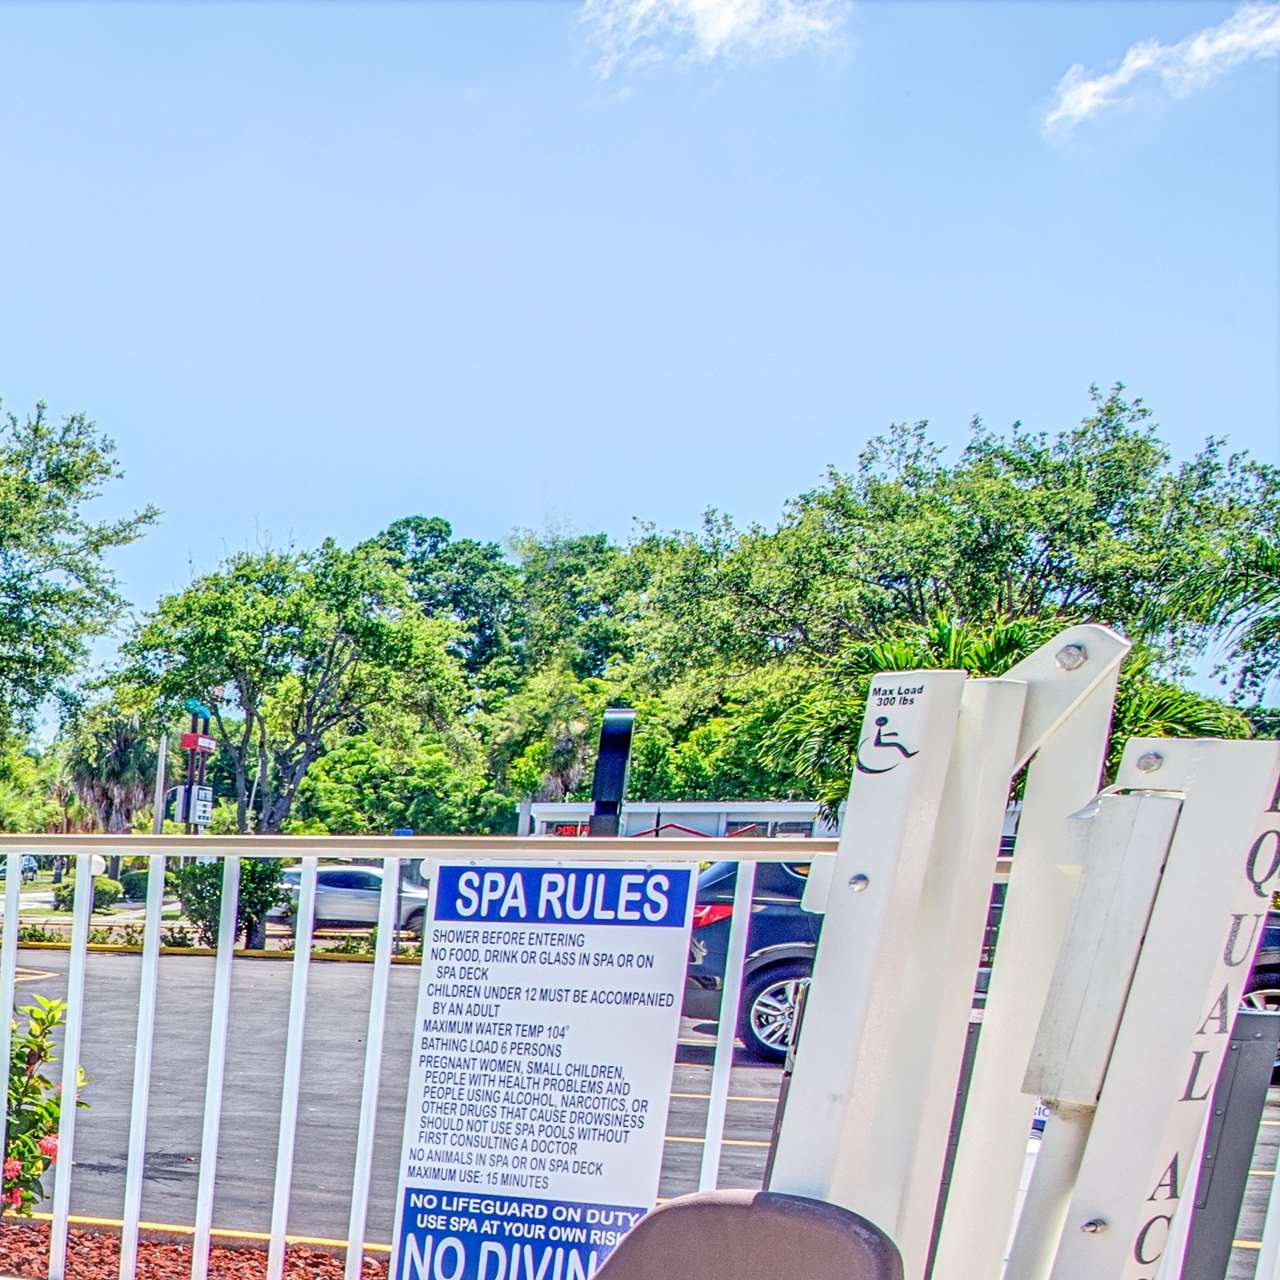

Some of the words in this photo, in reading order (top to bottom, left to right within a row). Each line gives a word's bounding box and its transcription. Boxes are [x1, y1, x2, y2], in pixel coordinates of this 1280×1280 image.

[872, 687, 894, 697] Max
[898, 685, 925, 696] Load
[876, 697, 895, 706] 300
[898, 697, 915, 706] lbs
[455, 871, 527, 918] SPA
[537, 872, 670, 922] RULES
[433, 929, 479, 943] SHOWER
[481, 931, 526, 945] BEFORE
[528, 932, 585, 947] ENTERING
[431, 948, 446, 961] NO
[449, 948, 481, 964] FOOD,
[484, 949, 518, 963] DRINK
[521, 951, 537, 964] OR
[539, 951, 576, 966] GLASS
[579, 953, 590, 966] IN
[593, 953, 614, 967] SPA
[617, 954, 634, 968] OR
[636, 955, 654, 968] ON
[436, 965, 456, 979] SPA
[459, 967, 489, 981] DECK
[427, 983, 482, 998] CHILDREN
[484, 986, 521, 1000] UNDER
[525, 988, 537, 1001] 12
[539, 988, 570, 1002] MUST
[573, 989, 589, 1003] BE
[590, 990, 674, 1007] ACCOMPANIED
[432, 1002, 447, 1015] BY
[448, 1002, 464, 1016] AN
[465, 1003, 501, 1018] ADULT
[423, 1019, 473, 1034] MAXIMUM
[475, 1021, 513, 1036] WATER
[515, 1024, 544, 1038] TEMP
[421, 1037, 467, 1052] BATHING
[470, 1040, 498, 1054] LOAD
[501, 1042, 508, 1055] 6
[509, 1042, 562, 1057] PERSONS
[419, 1055, 478, 1070] PREGNANT
[480, 1059, 523, 1074] WOMEN,
[527, 1061, 562, 1076] SMALL
[565, 1063, 625, 1080] CHILDREN,
[425, 1070, 466, 1086] PEOPLE
[468, 1073, 496, 1087] WITH
[498, 1075, 540, 1090] HEALTH
[543, 1077, 604, 1094] PROBLEMS
[606, 1081, 631, 1096] AND
[423, 1085, 465, 1101] PEOPLE
[467, 1088, 501, 1103] USING
[503, 1091, 557, 1108] ALCOHOL,
[560, 1095, 628, 1113] NARCOTICS,
[631, 1099, 649, 1113] OR
[421, 1101, 458, 1116] OTHER
[460, 1103, 497, 1119] DRUGS
[500, 1106, 528, 1120] THAT
[529, 1108, 567, 1124] CAUSE
[569, 1111, 645, 1129] DROWSINESS
[420, 1116, 464, 1131] SHOULD
[466, 1119, 488, 1133] NOT
[491, 1121, 513, 1135] USE
[514, 1122, 535, 1136] SPA
[538, 1124, 575, 1140] POOLS
[577, 1127, 631, 1144] WITHOUT
[419, 1131, 448, 1145] FIRST
[450, 1133, 519, 1151] CONSULTING
[520, 1139, 528, 1152] A
[531, 1139, 578, 1155] DOCTOR
[409, 1148, 425, 1161] NO
[427, 1149, 473, 1165] ANIMALS
[475, 1153, 487, 1166] IN
[488, 1154, 509, 1168] SPA
[511, 1156, 528, 1170] OR
[530, 1158, 547, 1171] ON
[548, 1159, 569, 1173] SPA
[572, 1160, 604, 1176] DECK
[407, 1165, 457, 1181] MAXIMUM
[459, 1170, 483, 1184] USE:
[486, 1172, 498, 1185] 15
[500, 1173, 549, 1190] MINUTES
[409, 1193, 438, 1210] NO
[441, 1196, 548, 1220] LIFEGUARD
[552, 1206, 581, 1223] ON
[586, 1209, 639, 1227] DUTY
[416, 1213, 446, 1230] USE
[449, 1216, 478, 1233] SPA
[480, 1220, 500, 1236] AT
[503, 1221, 546, 1240] YOUR
[548, 1226, 587, 1243] OWN
